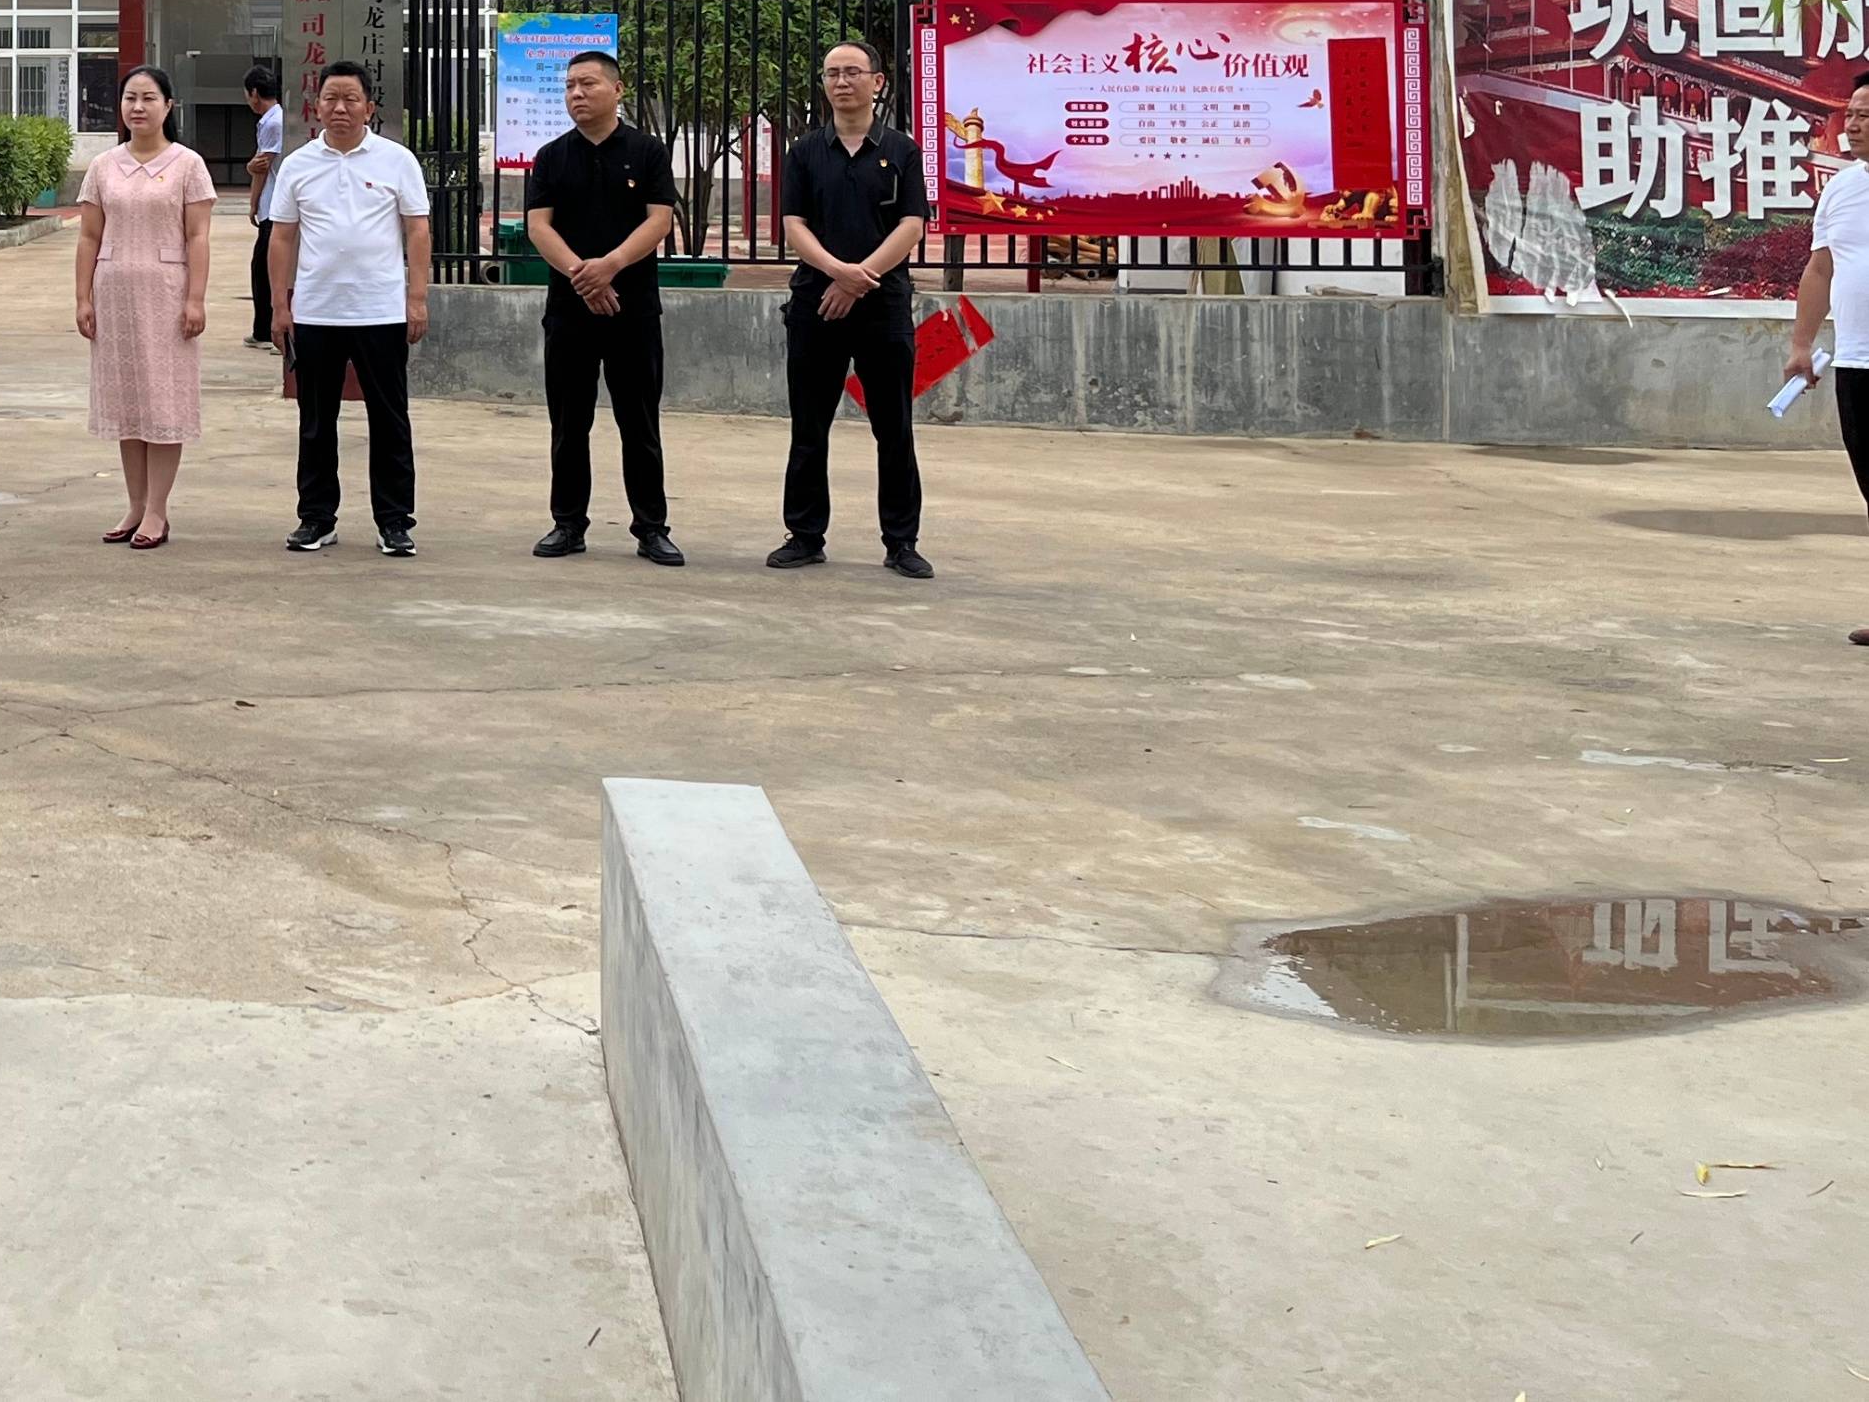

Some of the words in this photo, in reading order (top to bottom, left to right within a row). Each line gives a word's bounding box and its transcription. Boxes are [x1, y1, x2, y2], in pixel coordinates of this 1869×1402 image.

[1026, 32, 1310, 79] 社会主义核心价值观
[1202, 103, 1219, 112] 文明
